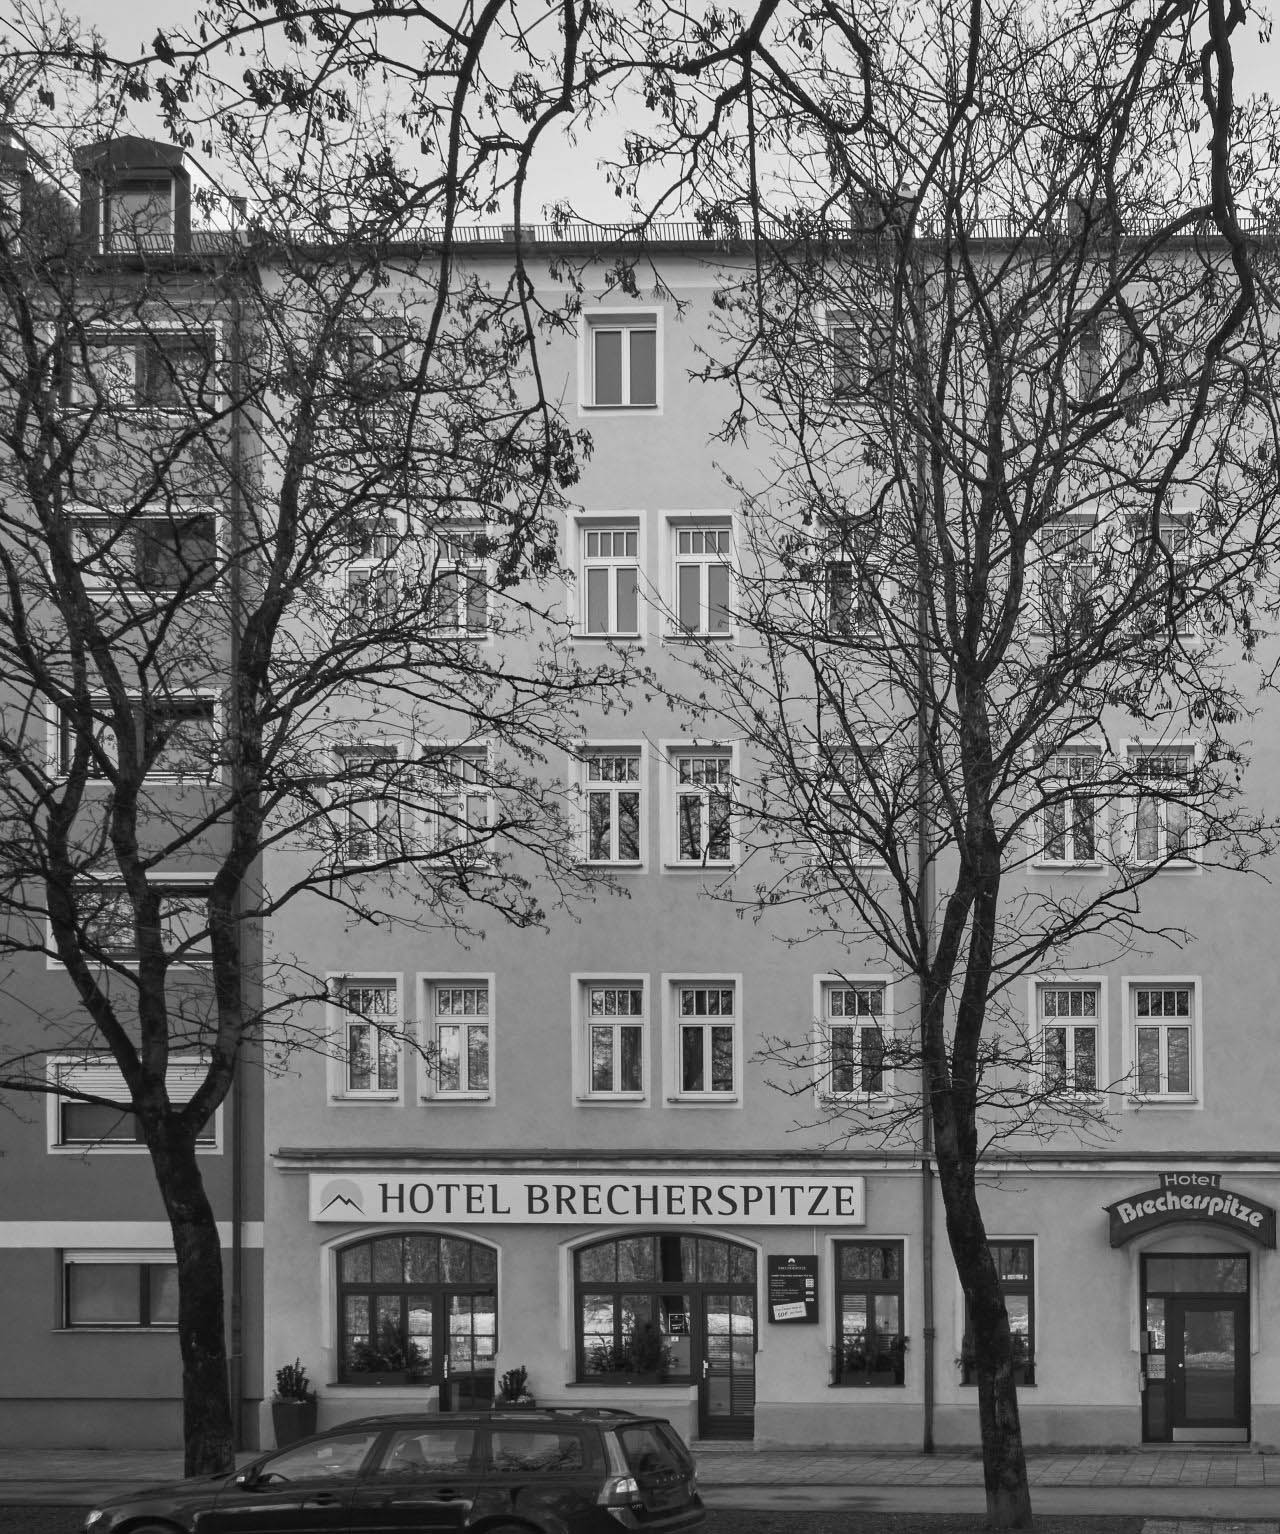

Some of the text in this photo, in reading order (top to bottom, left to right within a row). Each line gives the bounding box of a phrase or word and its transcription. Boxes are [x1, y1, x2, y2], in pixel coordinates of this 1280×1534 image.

[1164, 1174, 1216, 1187] Hotel
[378, 1183, 856, 1216] HOTEL BRECHERSPITZE
[1116, 1191, 1264, 1228] Brecherspitze
